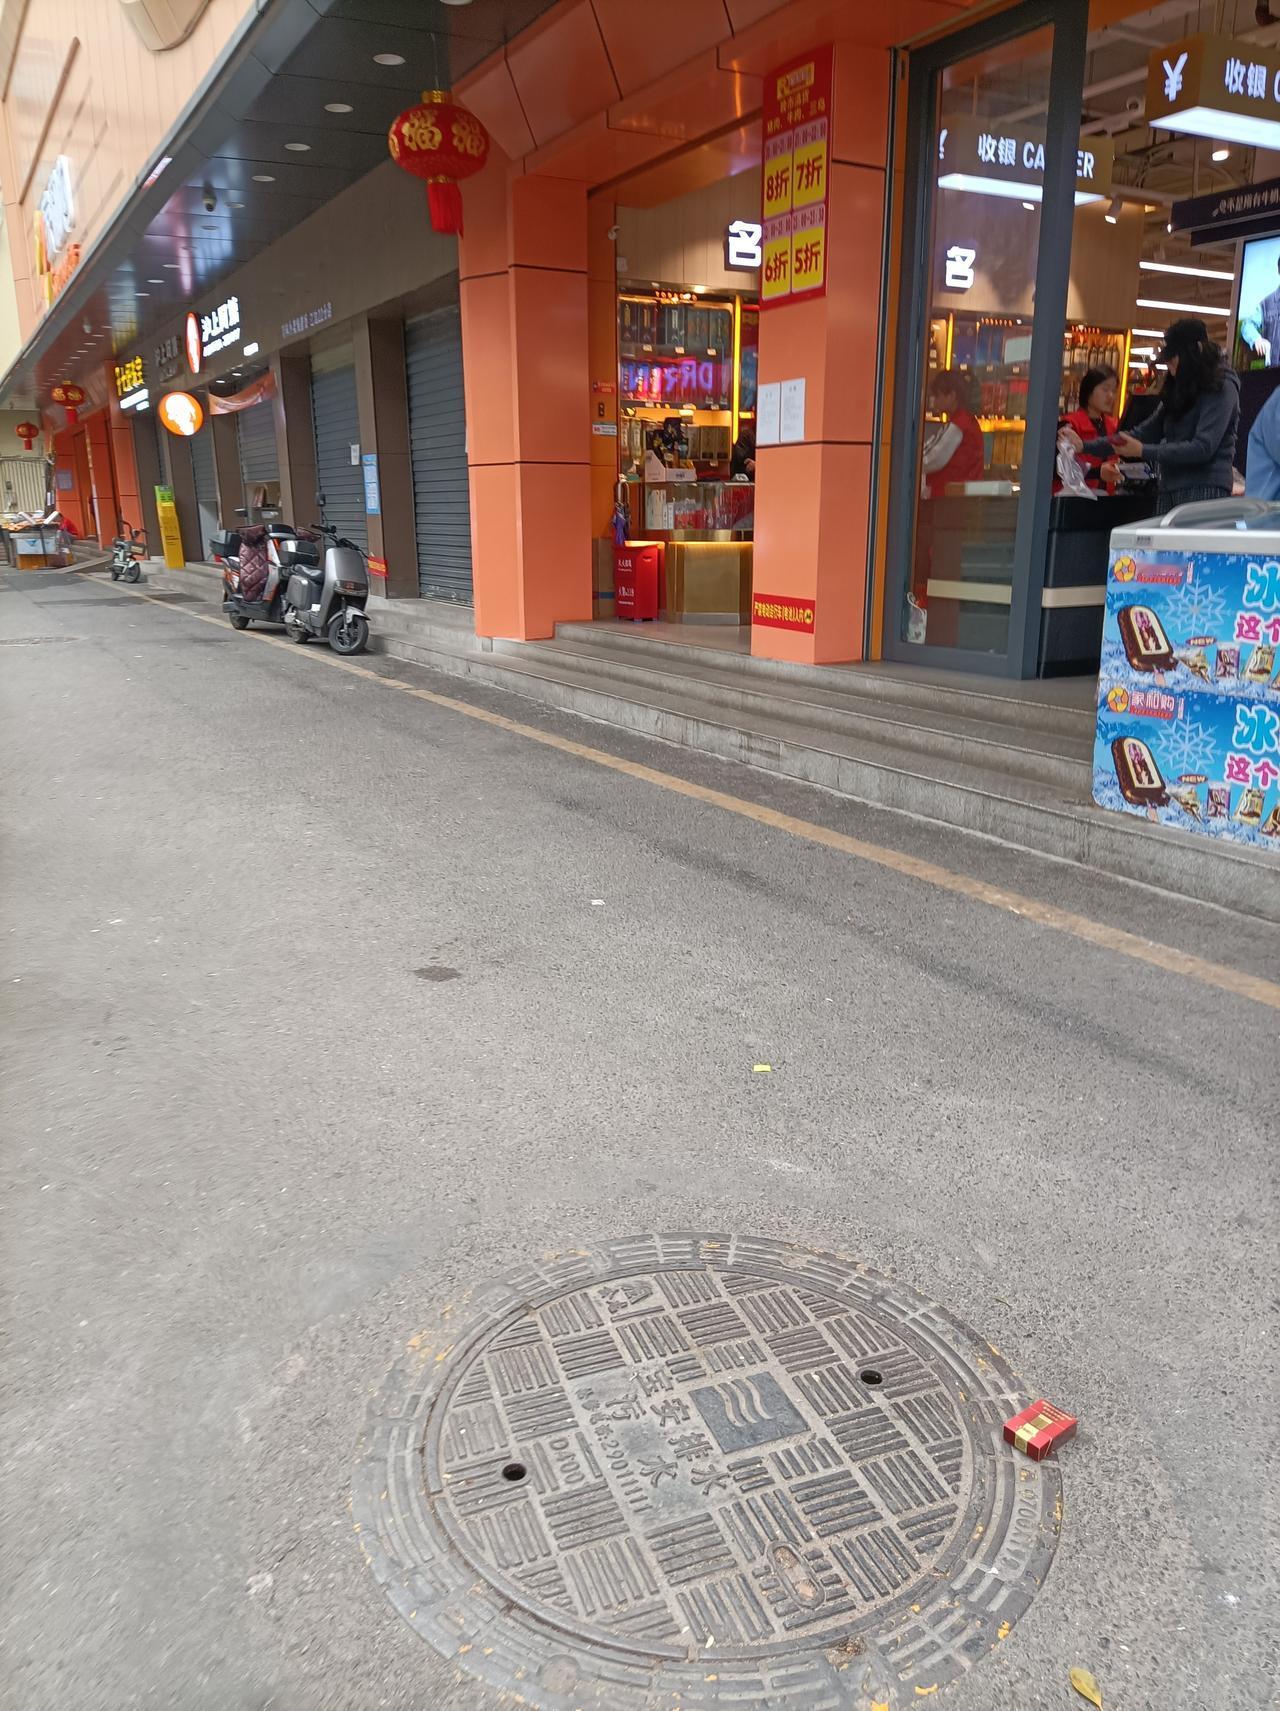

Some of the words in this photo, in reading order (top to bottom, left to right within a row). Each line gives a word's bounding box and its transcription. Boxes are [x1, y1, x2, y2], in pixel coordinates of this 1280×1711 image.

[1224, 57, 1266, 99] 收银
[795, 154, 823, 190] 7折
[977, 132, 1016, 167] 收银
[1022, 141, 1095, 179] CAER
[766, 167, 790, 202] 8折
[728, 220, 762, 268] 名
[794, 240, 821, 274] 5折
[765, 249, 789, 282] 6折
[944, 245, 976, 290] 名
[1190, 637, 1214, 646] NEW
[1234, 707, 1277, 752] 冰
[1181, 775, 1206, 783] NEW
[1226, 754, 1279, 787] 这个
[636, 1369, 730, 1496] 宝安排水
[549, 1437, 585, 1485] D400
